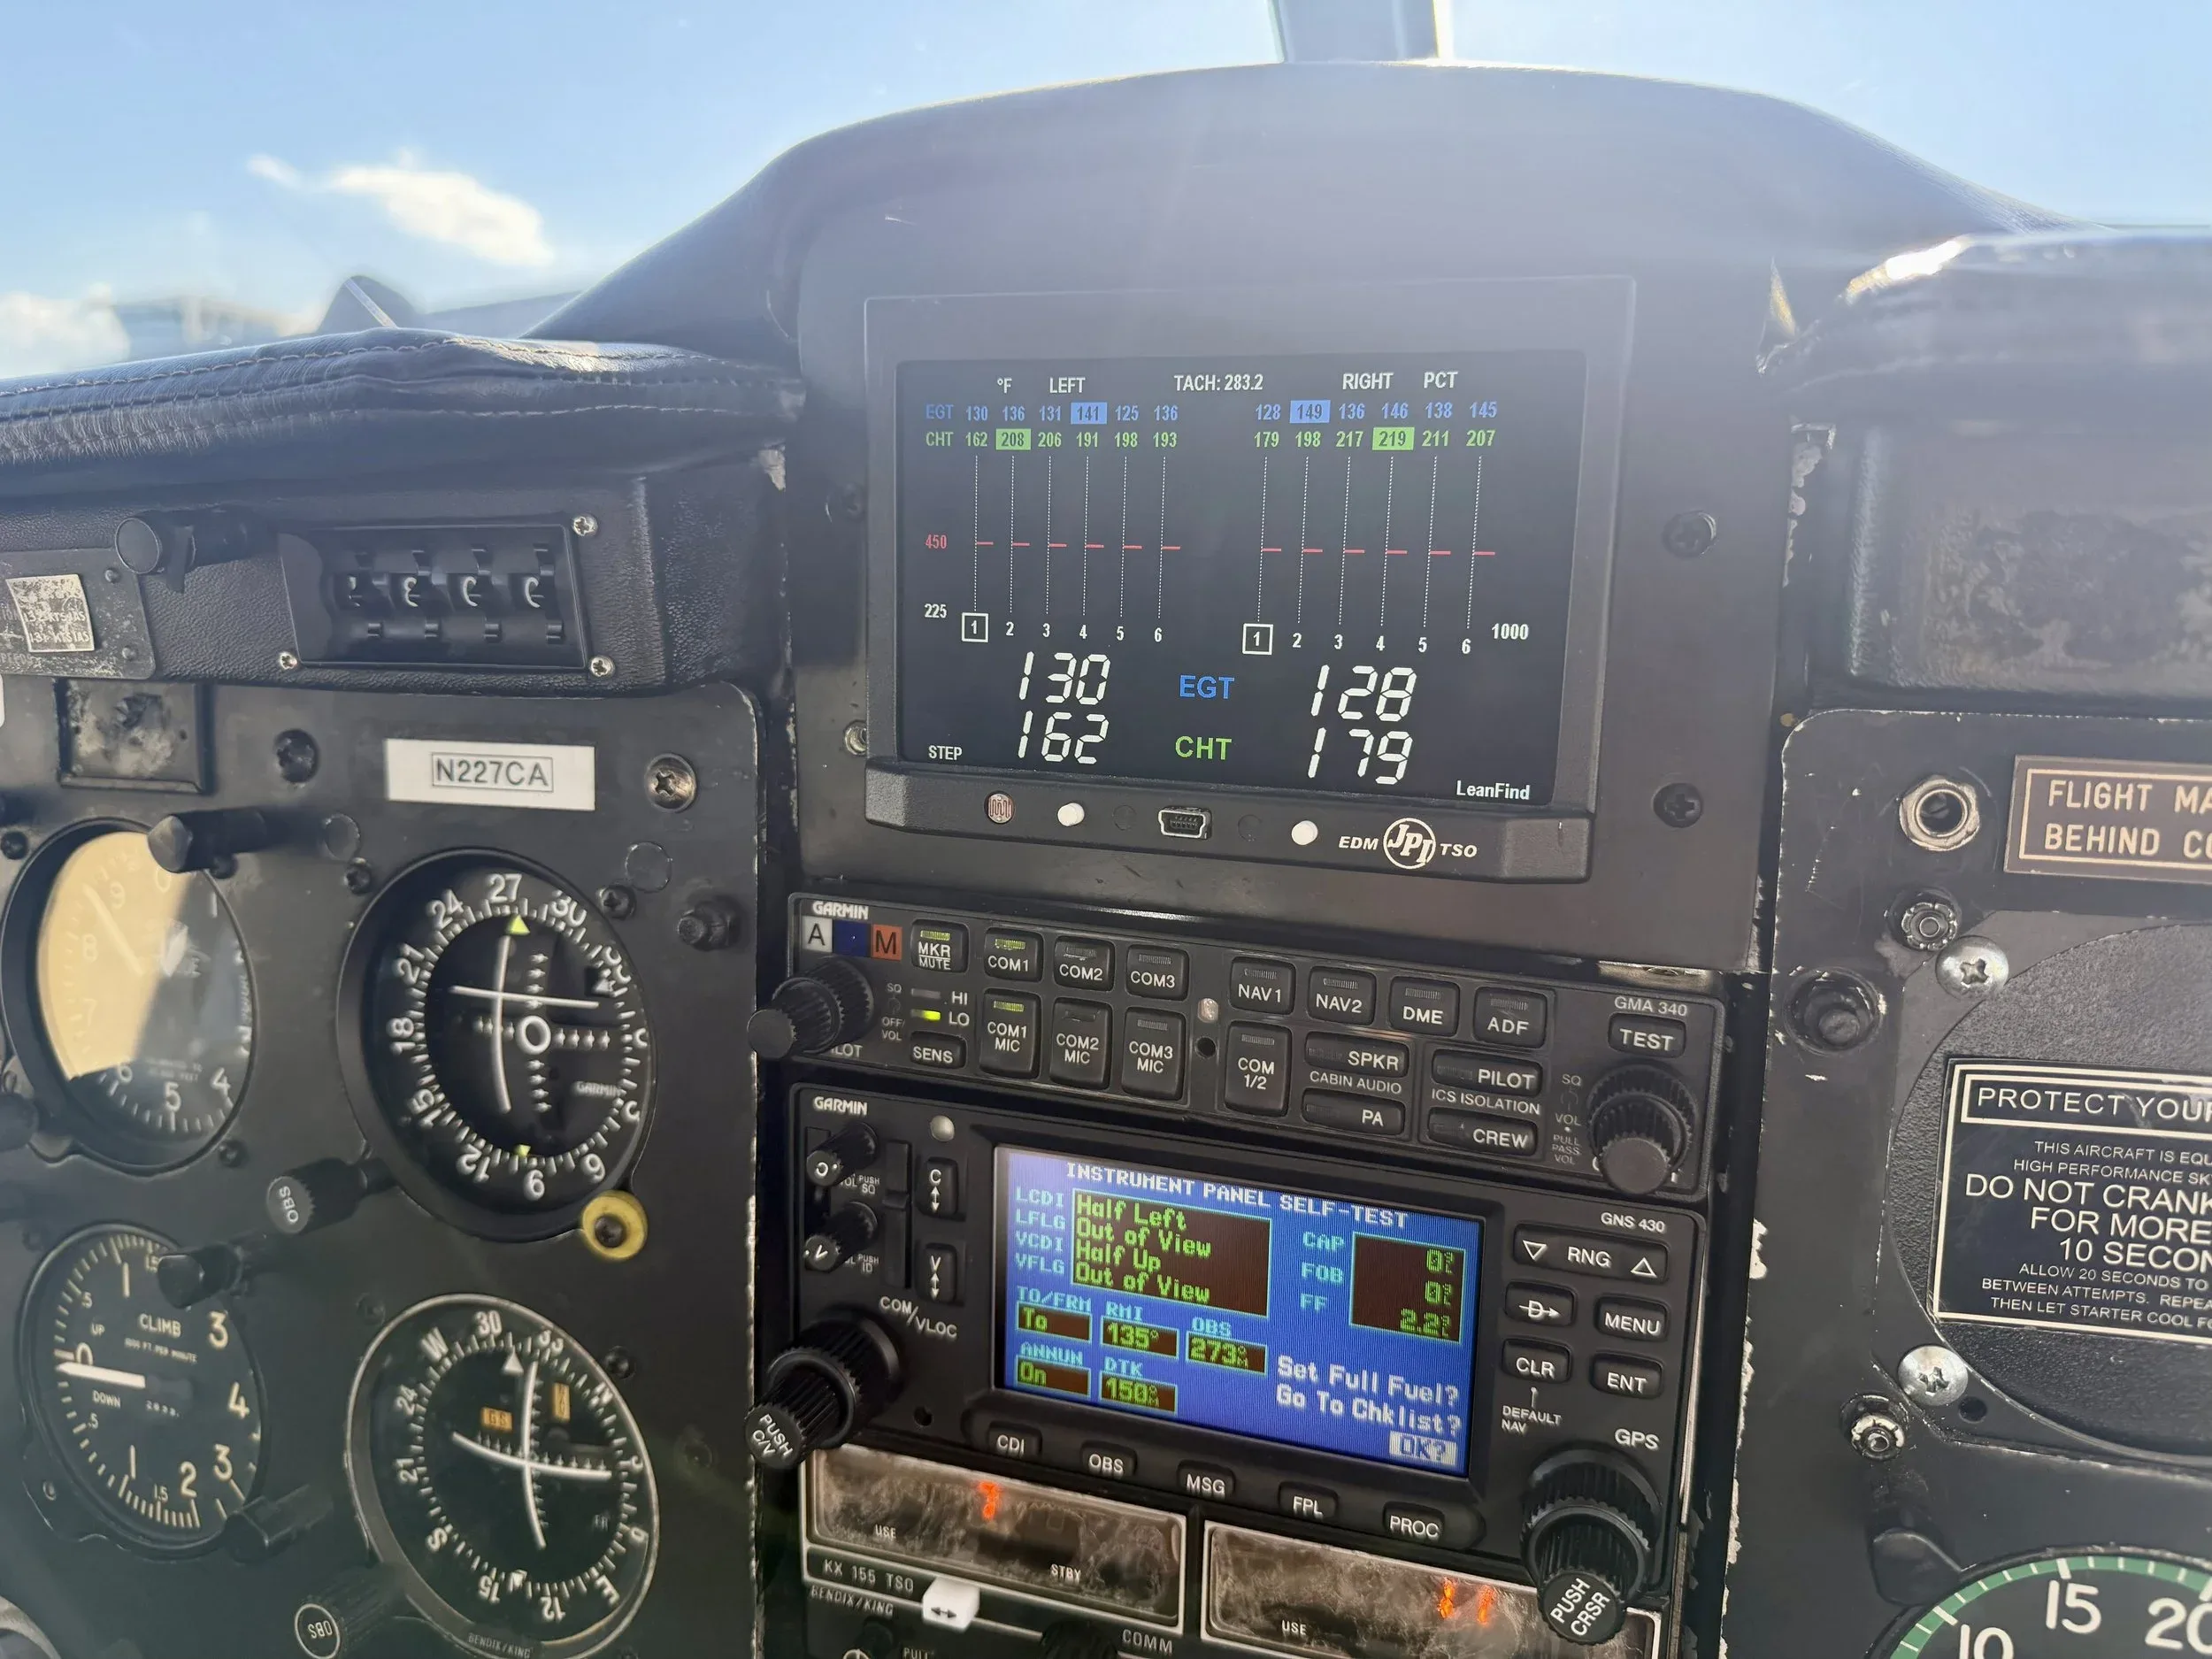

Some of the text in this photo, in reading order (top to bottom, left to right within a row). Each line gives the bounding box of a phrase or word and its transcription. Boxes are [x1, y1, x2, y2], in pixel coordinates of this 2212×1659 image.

[1049, 372, 1458, 394] LEFT TACH: 283.2 RIGHT PCT
[926, 401, 1498, 421] EGT 130 136 131 141 125 136 128 146 138 145
[926, 429, 1495, 448] CHT 162 208 206 191 198 193 179 198 217 211 207
[925, 534, 948, 549] 450
[925, 603, 947, 618] 225
[1491, 623, 1529, 641] 1000
[1018, 651, 1417, 722] 130 EGT 128
[928, 745, 963, 761] STEP
[1018, 710, 1413, 785] 162 CHT 179
[436, 758, 549, 787] N227CA
[1456, 780, 1531, 800] LeanFind
[2048, 780, 2153, 811] FLIGHT
[1339, 835, 1478, 857] EDM TSO
[2044, 823, 2160, 856] BEHIND
[487, 873, 522, 902] 27
[426, 888, 463, 930] 24
[812, 901, 869, 919] GARMIN
[918, 941, 951, 956] MKR
[919, 956, 951, 970] MUTE
[951, 991, 968, 1005] HI
[1614, 995, 1688, 1017] GMA 340
[949, 1012, 970, 1026] LO
[1402, 1006, 1443, 1025] DME
[1487, 1018, 1529, 1035] ADF
[995, 1037, 1020, 1052] MIC
[1619, 1028, 1674, 1051] TEST
[913, 1046, 953, 1064] SENS
[1064, 1050, 1091, 1064] MIC
[1137, 1058, 1164, 1073] MIC
[1238, 1057, 1275, 1075] COM
[1348, 1050, 1399, 1071] SPKR
[1310, 1071, 1402, 1094] CABIN AUDIO
[1478, 1069, 1535, 1090] PILOT
[813, 1095, 868, 1116] GARMIN
[1432, 1089, 1540, 1116] ICS ISOLATION
[1978, 1087, 2125, 1115] PROTECT
[1362, 1110, 1384, 1126] PA
[1555, 1112, 1581, 1126] VOL
[1472, 1128, 1528, 1148] CREW
[1553, 1133, 1580, 1146] PULL
[1552, 1144, 1580, 1156] PASS
[2034, 1141, 2174, 1162] THIS AIRCRAFT IS
[2014, 1159, 2183, 1183] HIGH PERFORMANCE
[1066, 1161, 1409, 1229] INSTRUMENT PANEL SELF-TEST
[1965, 1173, 2094, 1205] DO NOT
[278, 1186, 299, 1224] OBS
[1016, 1187, 1187, 1232] LCDI Half Left
[1600, 1212, 1666, 1233] GNS 430
[2031, 1207, 2100, 1235] FOR
[1076, 1217, 1211, 1259] Out of View
[1076, 1240, 1161, 1273] Half Up
[1567, 1246, 1612, 1268] RNG
[2059, 1238, 2093, 1262] 10
[1075, 1262, 1210, 1304] Out of View
[1982, 1278, 2058, 1295] BETWEEN
[2018, 1263, 2208, 1292] ALLOW 20 SECONDS TO
[1019, 1286, 1092, 1312] TO/FRM
[879, 1295, 957, 1338] COM/VLOC
[1991, 1296, 2192, 1328] THEN LET STARTER COOL
[91, 1324, 105, 1336] UP
[137, 1313, 182, 1339] CLIMB
[208, 1310, 229, 1349] 3
[473, 1310, 502, 1338] 30
[1192, 1317, 1232, 1337] OBS
[1604, 1312, 1662, 1335] MENU
[419, 1327, 449, 1363] W
[1020, 1362, 1047, 1386] On
[1278, 1355, 1378, 1392] Set Full
[1516, 1356, 1555, 1378] CLR
[1607, 1372, 1647, 1394] ENT
[93, 1390, 121, 1409] DOWN
[227, 1381, 250, 1419] 4
[1276, 1384, 1344, 1415] Go To
[1502, 1405, 1563, 1426] DEFAULT
[1502, 1419, 1527, 1434] NAV
[996, 1433, 1025, 1453] CDI
[1615, 1428, 1661, 1450] GPS
[213, 1443, 233, 1481] 3
[1088, 1453, 1124, 1474] OBS
[180, 1461, 197, 1498] 2
[1187, 1473, 1225, 1494] MSG
[1293, 1495, 1324, 1516] FPL
[875, 1525, 896, 1541] USE
[1390, 1515, 1440, 1538] PROC
[824, 1559, 914, 1593] KX 155 TSO
[1050, 1563, 1082, 1583] STBY
[810, 1586, 894, 1616] BENDIX/KING
[1550, 1577, 1591, 1624] PUSH
[2045, 1579, 2101, 1634] 15
[1571, 1591, 1611, 1637] CRSR
[1282, 1619, 1307, 1635] USE
[1122, 1629, 1173, 1655] COMM
